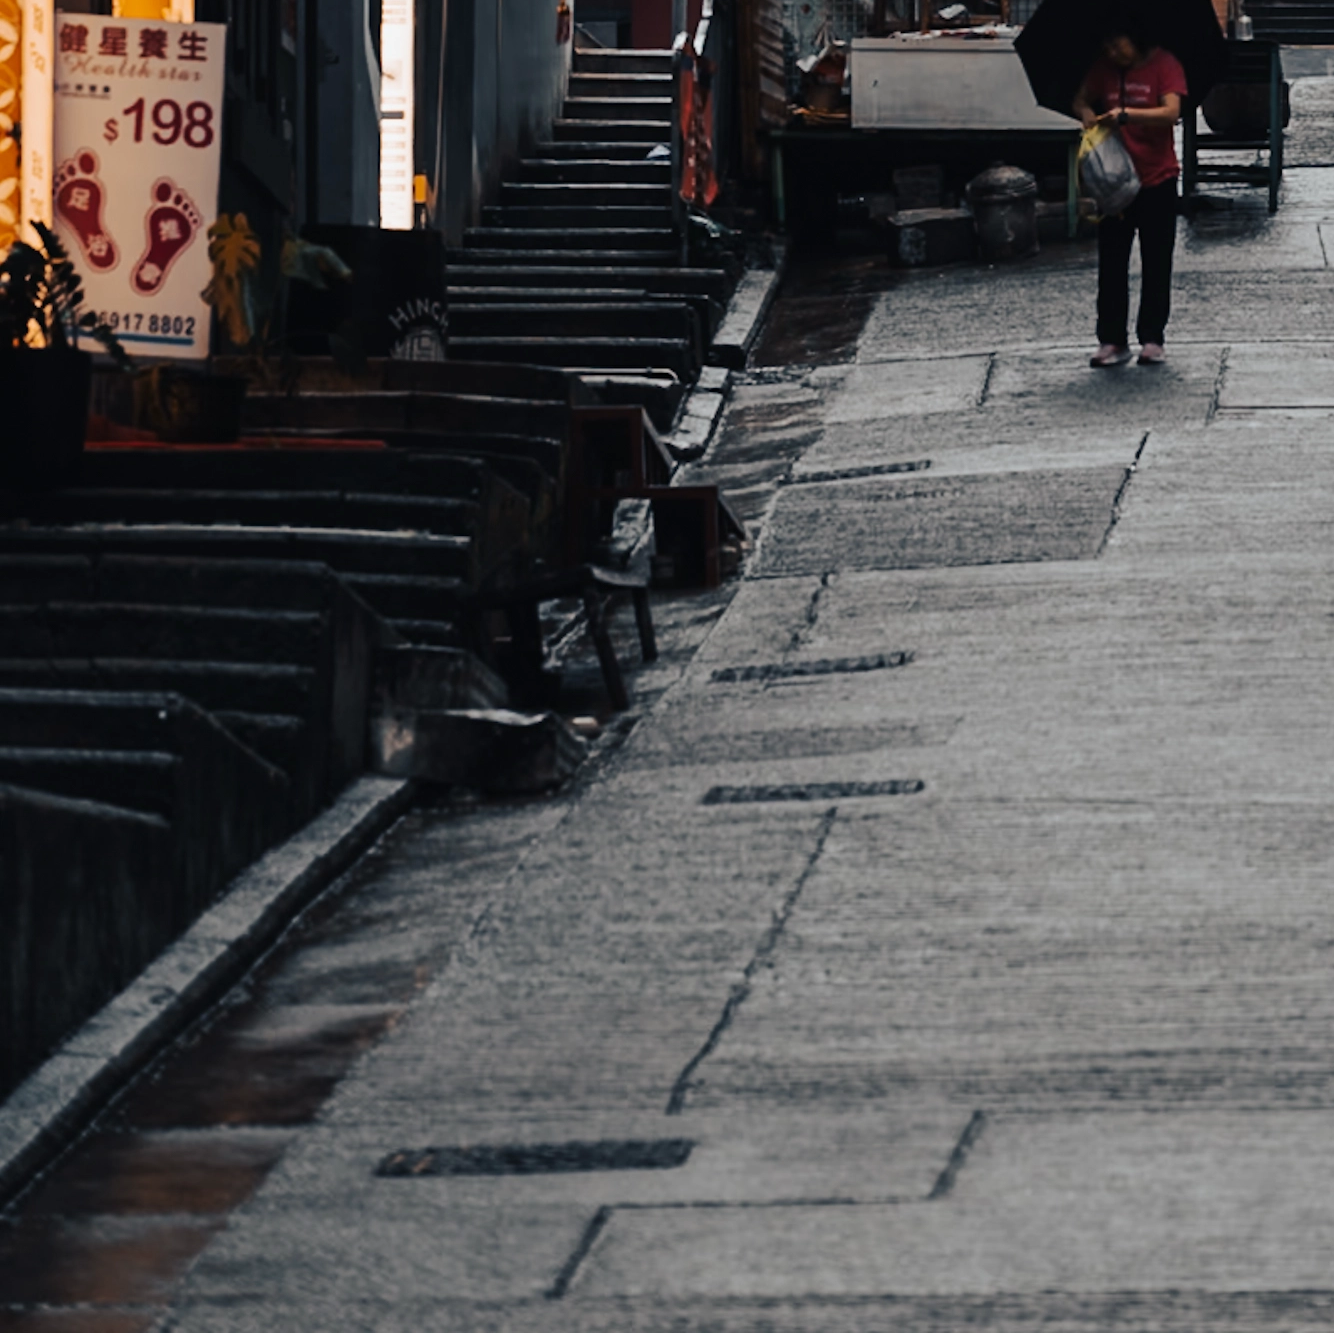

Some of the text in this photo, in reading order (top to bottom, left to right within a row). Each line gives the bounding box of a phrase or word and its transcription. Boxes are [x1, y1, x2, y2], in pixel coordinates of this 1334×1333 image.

[59, 23, 209, 62] 健星養生
[63, 54, 152, 79] Health
[102, 96, 215, 149] $198
[147, 315, 197, 336] 8802
